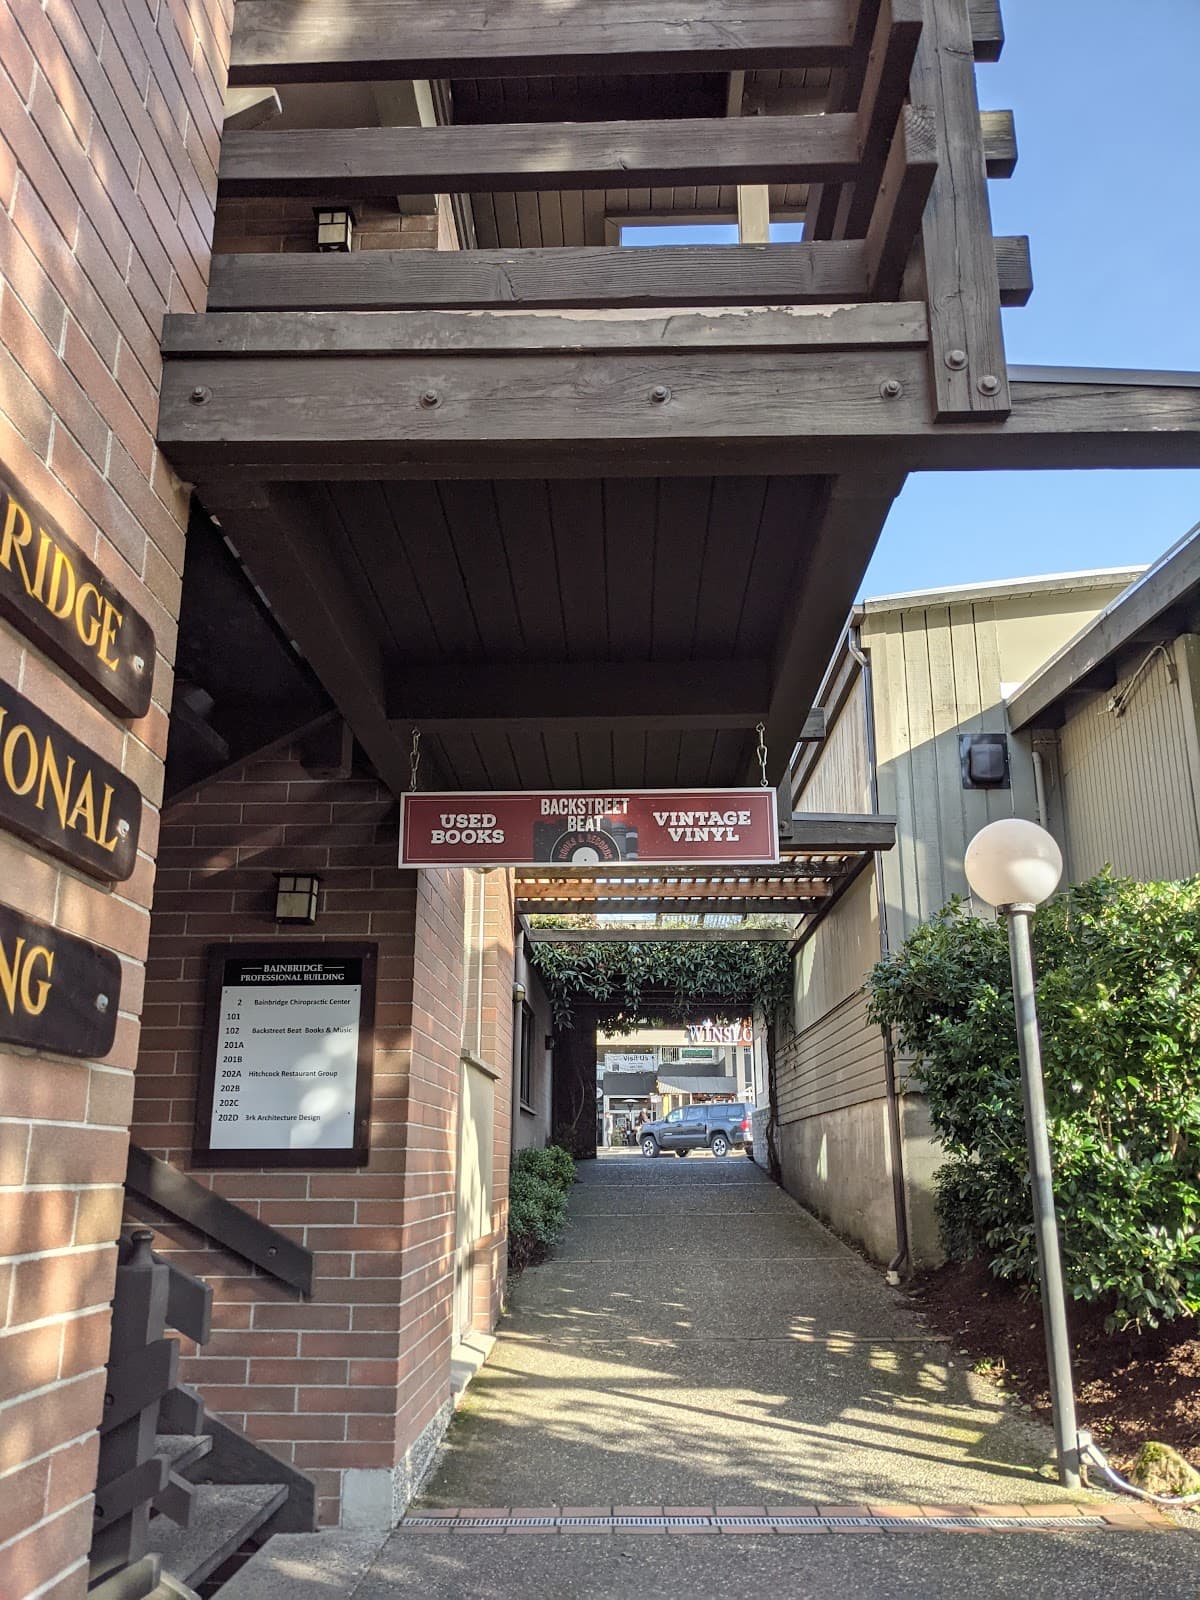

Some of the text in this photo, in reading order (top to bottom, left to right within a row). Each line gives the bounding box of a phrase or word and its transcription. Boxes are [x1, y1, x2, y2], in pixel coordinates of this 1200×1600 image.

[0, 494, 123, 672] RIDGE
[0, 706, 118, 853] ONAL
[540, 798, 630, 815] BACKSTREET
[439, 814, 497, 829] USED
[652, 810, 752, 827] VINTAGE
[567, 815, 604, 832] BEAT
[430, 829, 505, 845] BOOKS
[667, 826, 740, 842] VINYL
[263, 964, 323, 973] BAINBRIDGE
[240, 973, 345, 982] PROFESSIONAL BUILDING
[237, 999, 243, 1007] 2
[254, 999, 289, 1007] Bainbridge
[289, 998, 328, 1006] Chiropractic
[224, 1041, 244, 1049] 201A
[221, 1070, 242, 1078] 202A
[317, 1070, 338, 1078] Group
[219, 1099, 239, 1107] 202C
[218, 1114, 239, 1122] 202D
[298, 1114, 321, 1122] Design
